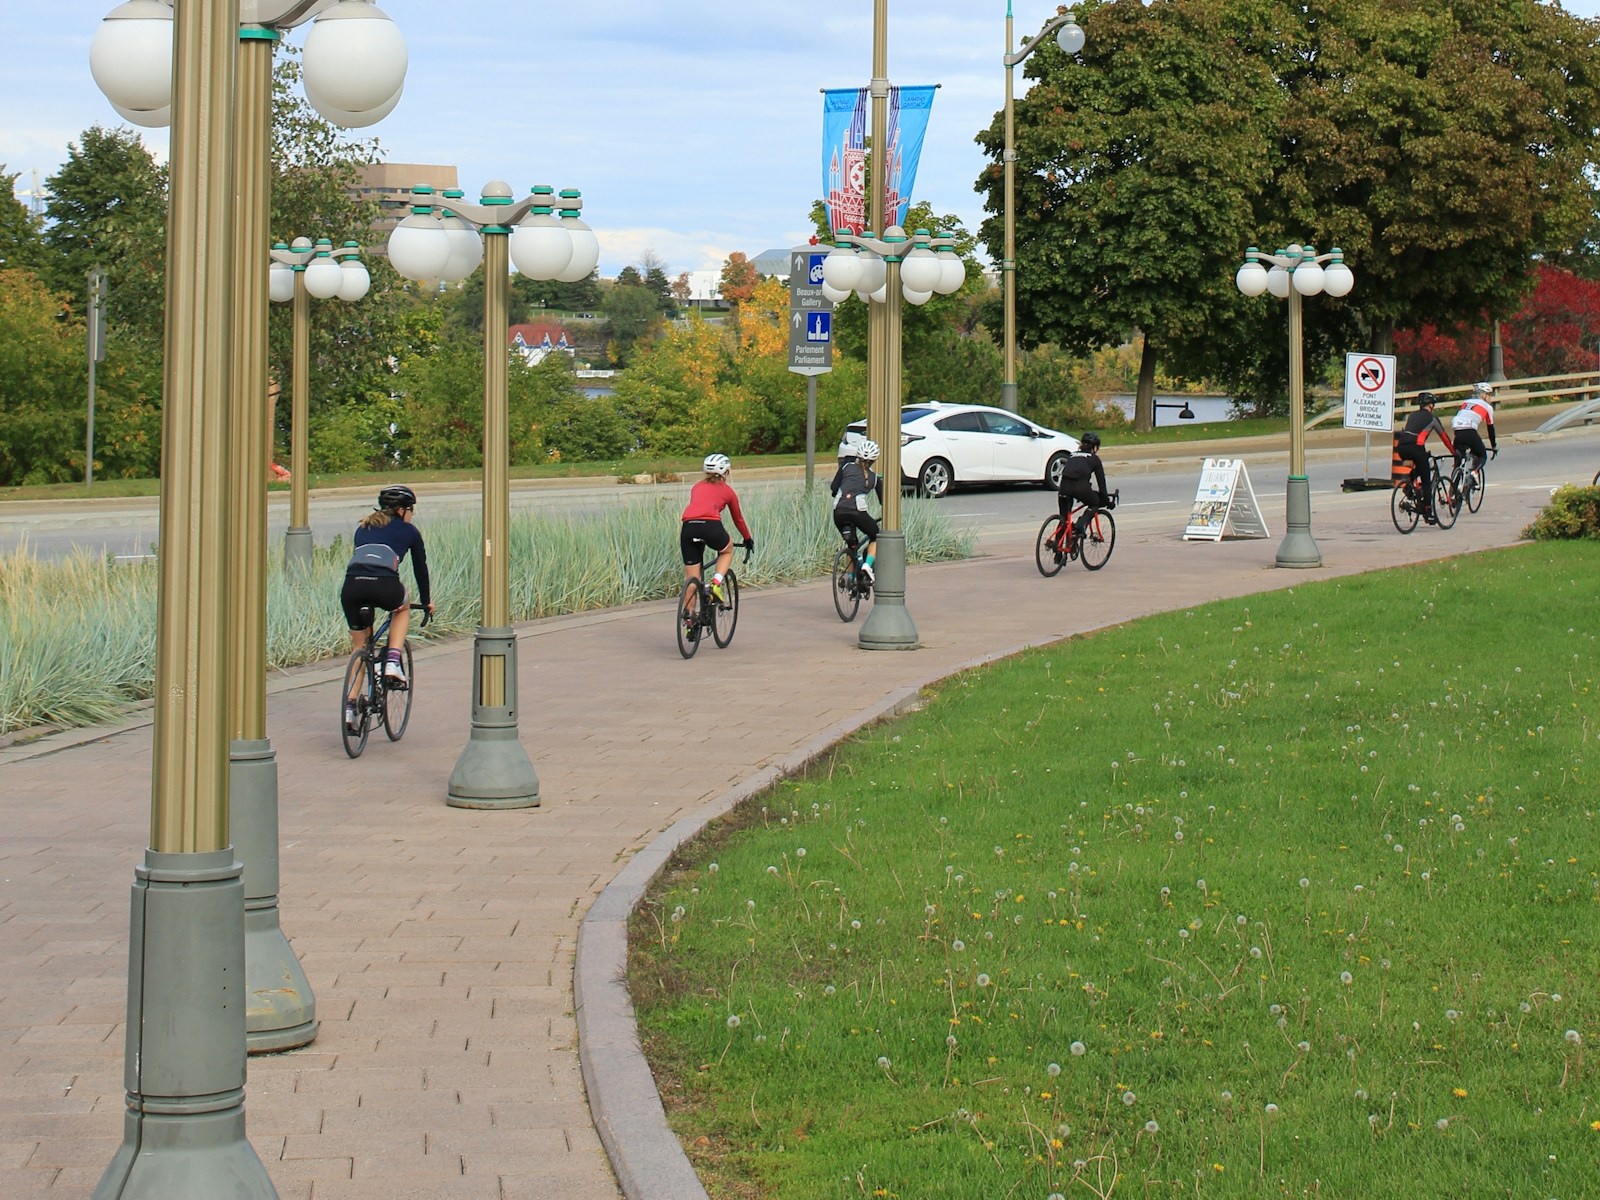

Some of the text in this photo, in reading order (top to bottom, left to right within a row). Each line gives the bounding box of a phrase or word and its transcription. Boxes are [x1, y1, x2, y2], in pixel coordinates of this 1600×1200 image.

[801, 298, 822, 307] Gallery
[795, 345, 825, 354] Parlement
[794, 355, 825, 365] Parliament
[1356, 412, 1382, 420] MAXIMUM
[1363, 419, 1384, 427] TONNES
